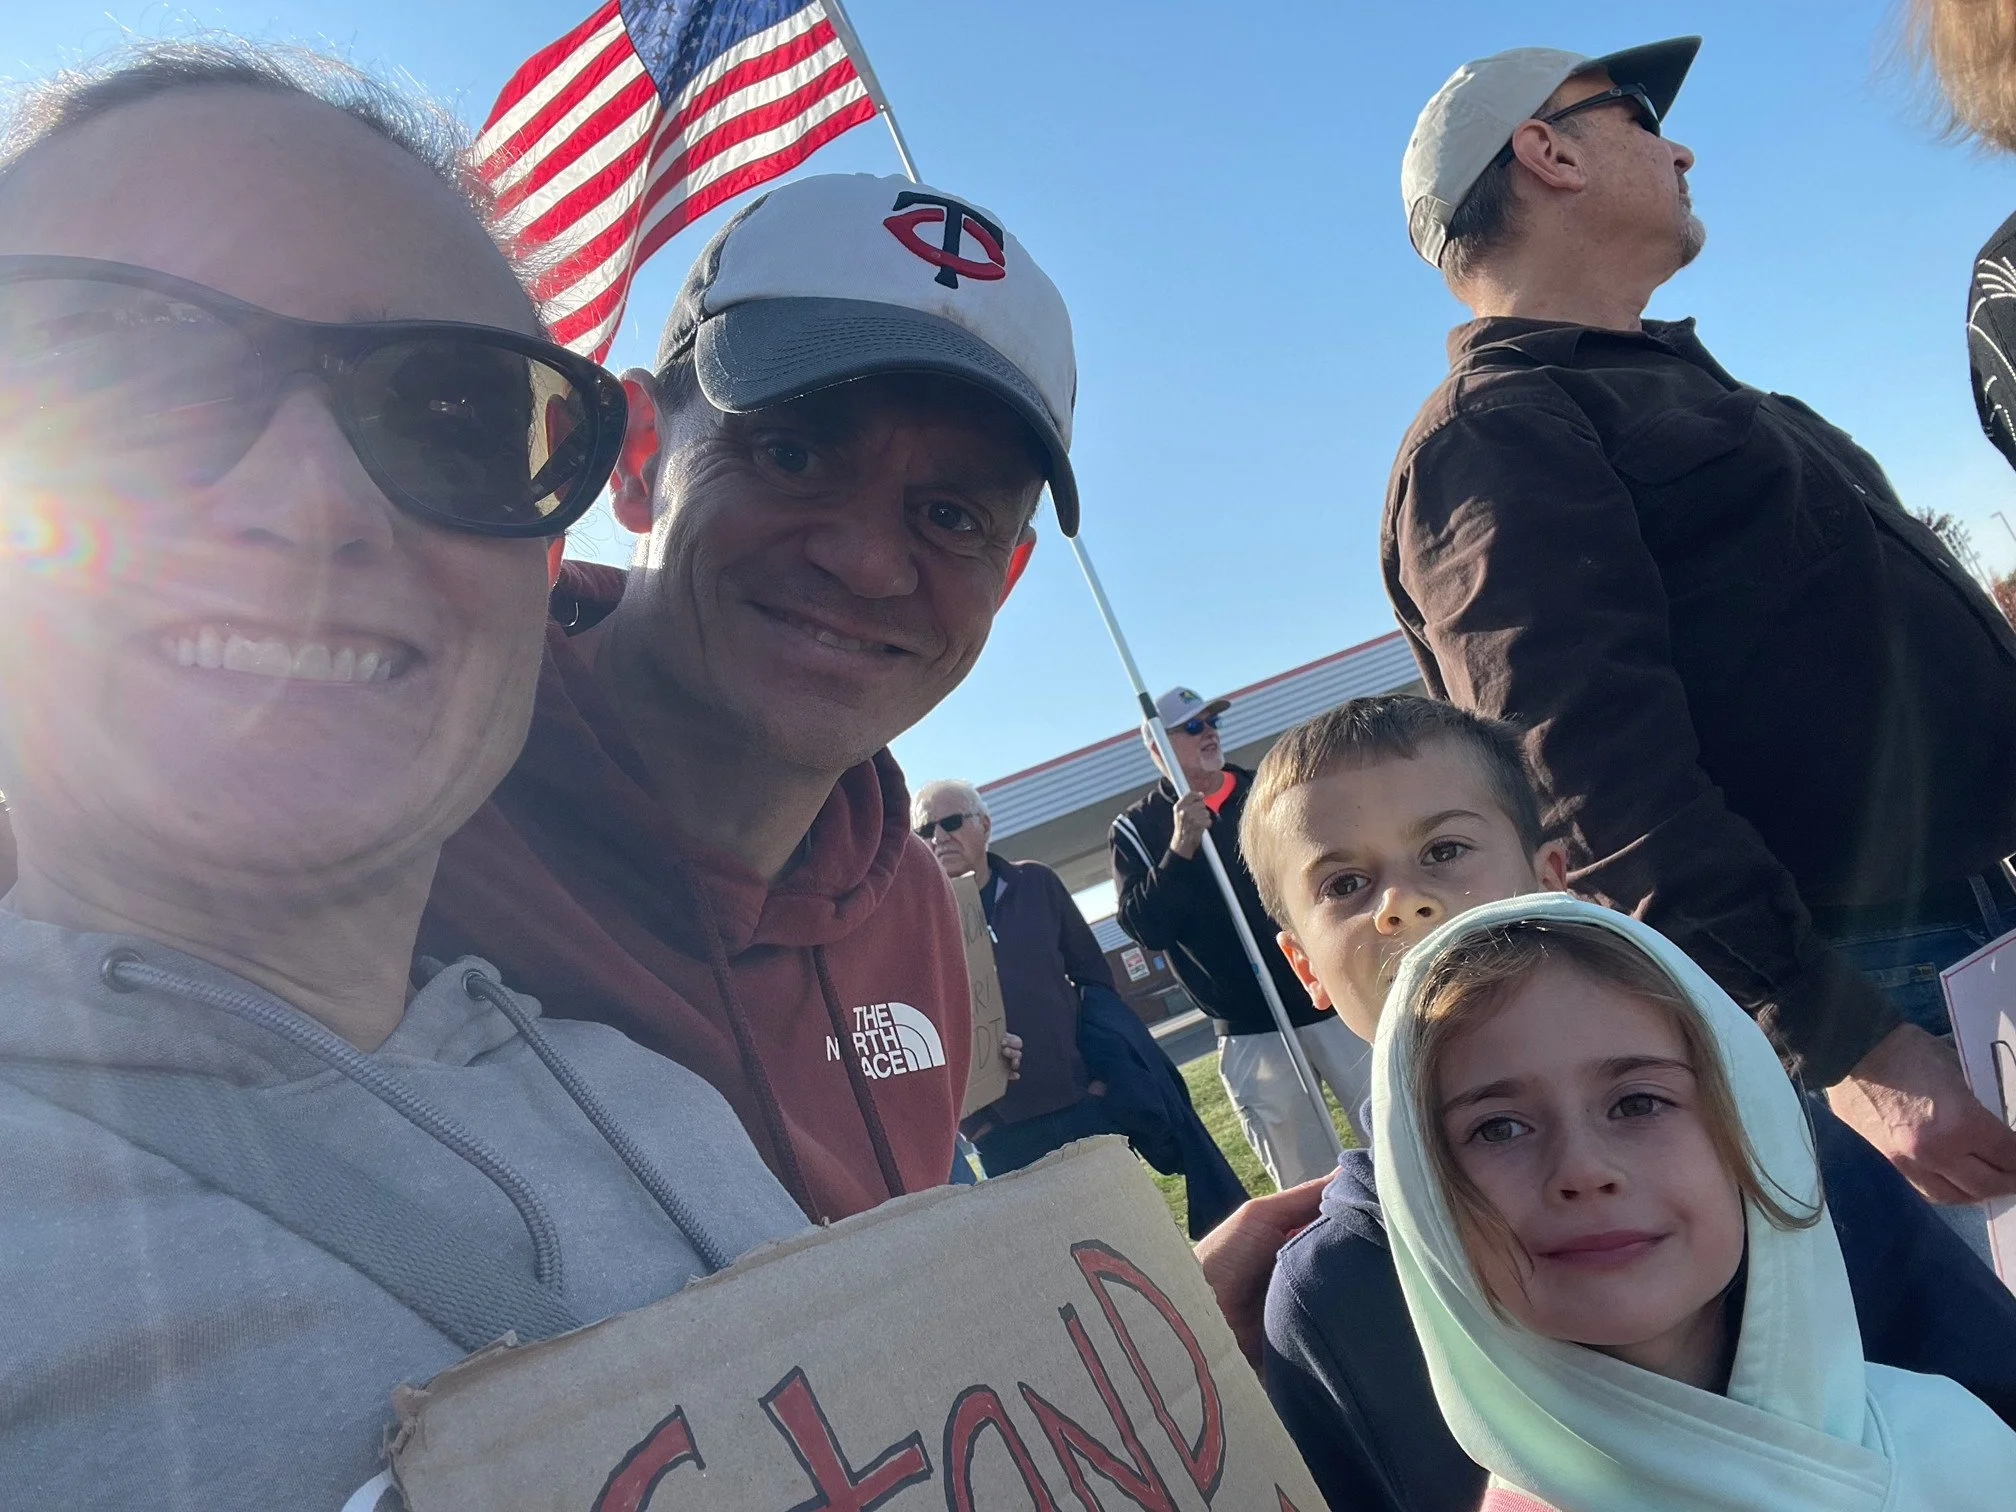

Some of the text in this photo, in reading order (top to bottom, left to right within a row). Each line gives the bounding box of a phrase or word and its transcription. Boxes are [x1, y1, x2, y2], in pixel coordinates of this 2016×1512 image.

[853, 1004, 892, 1031] THE
[826, 1026, 900, 1061] NRTH
[861, 1050, 907, 1080] ACE
